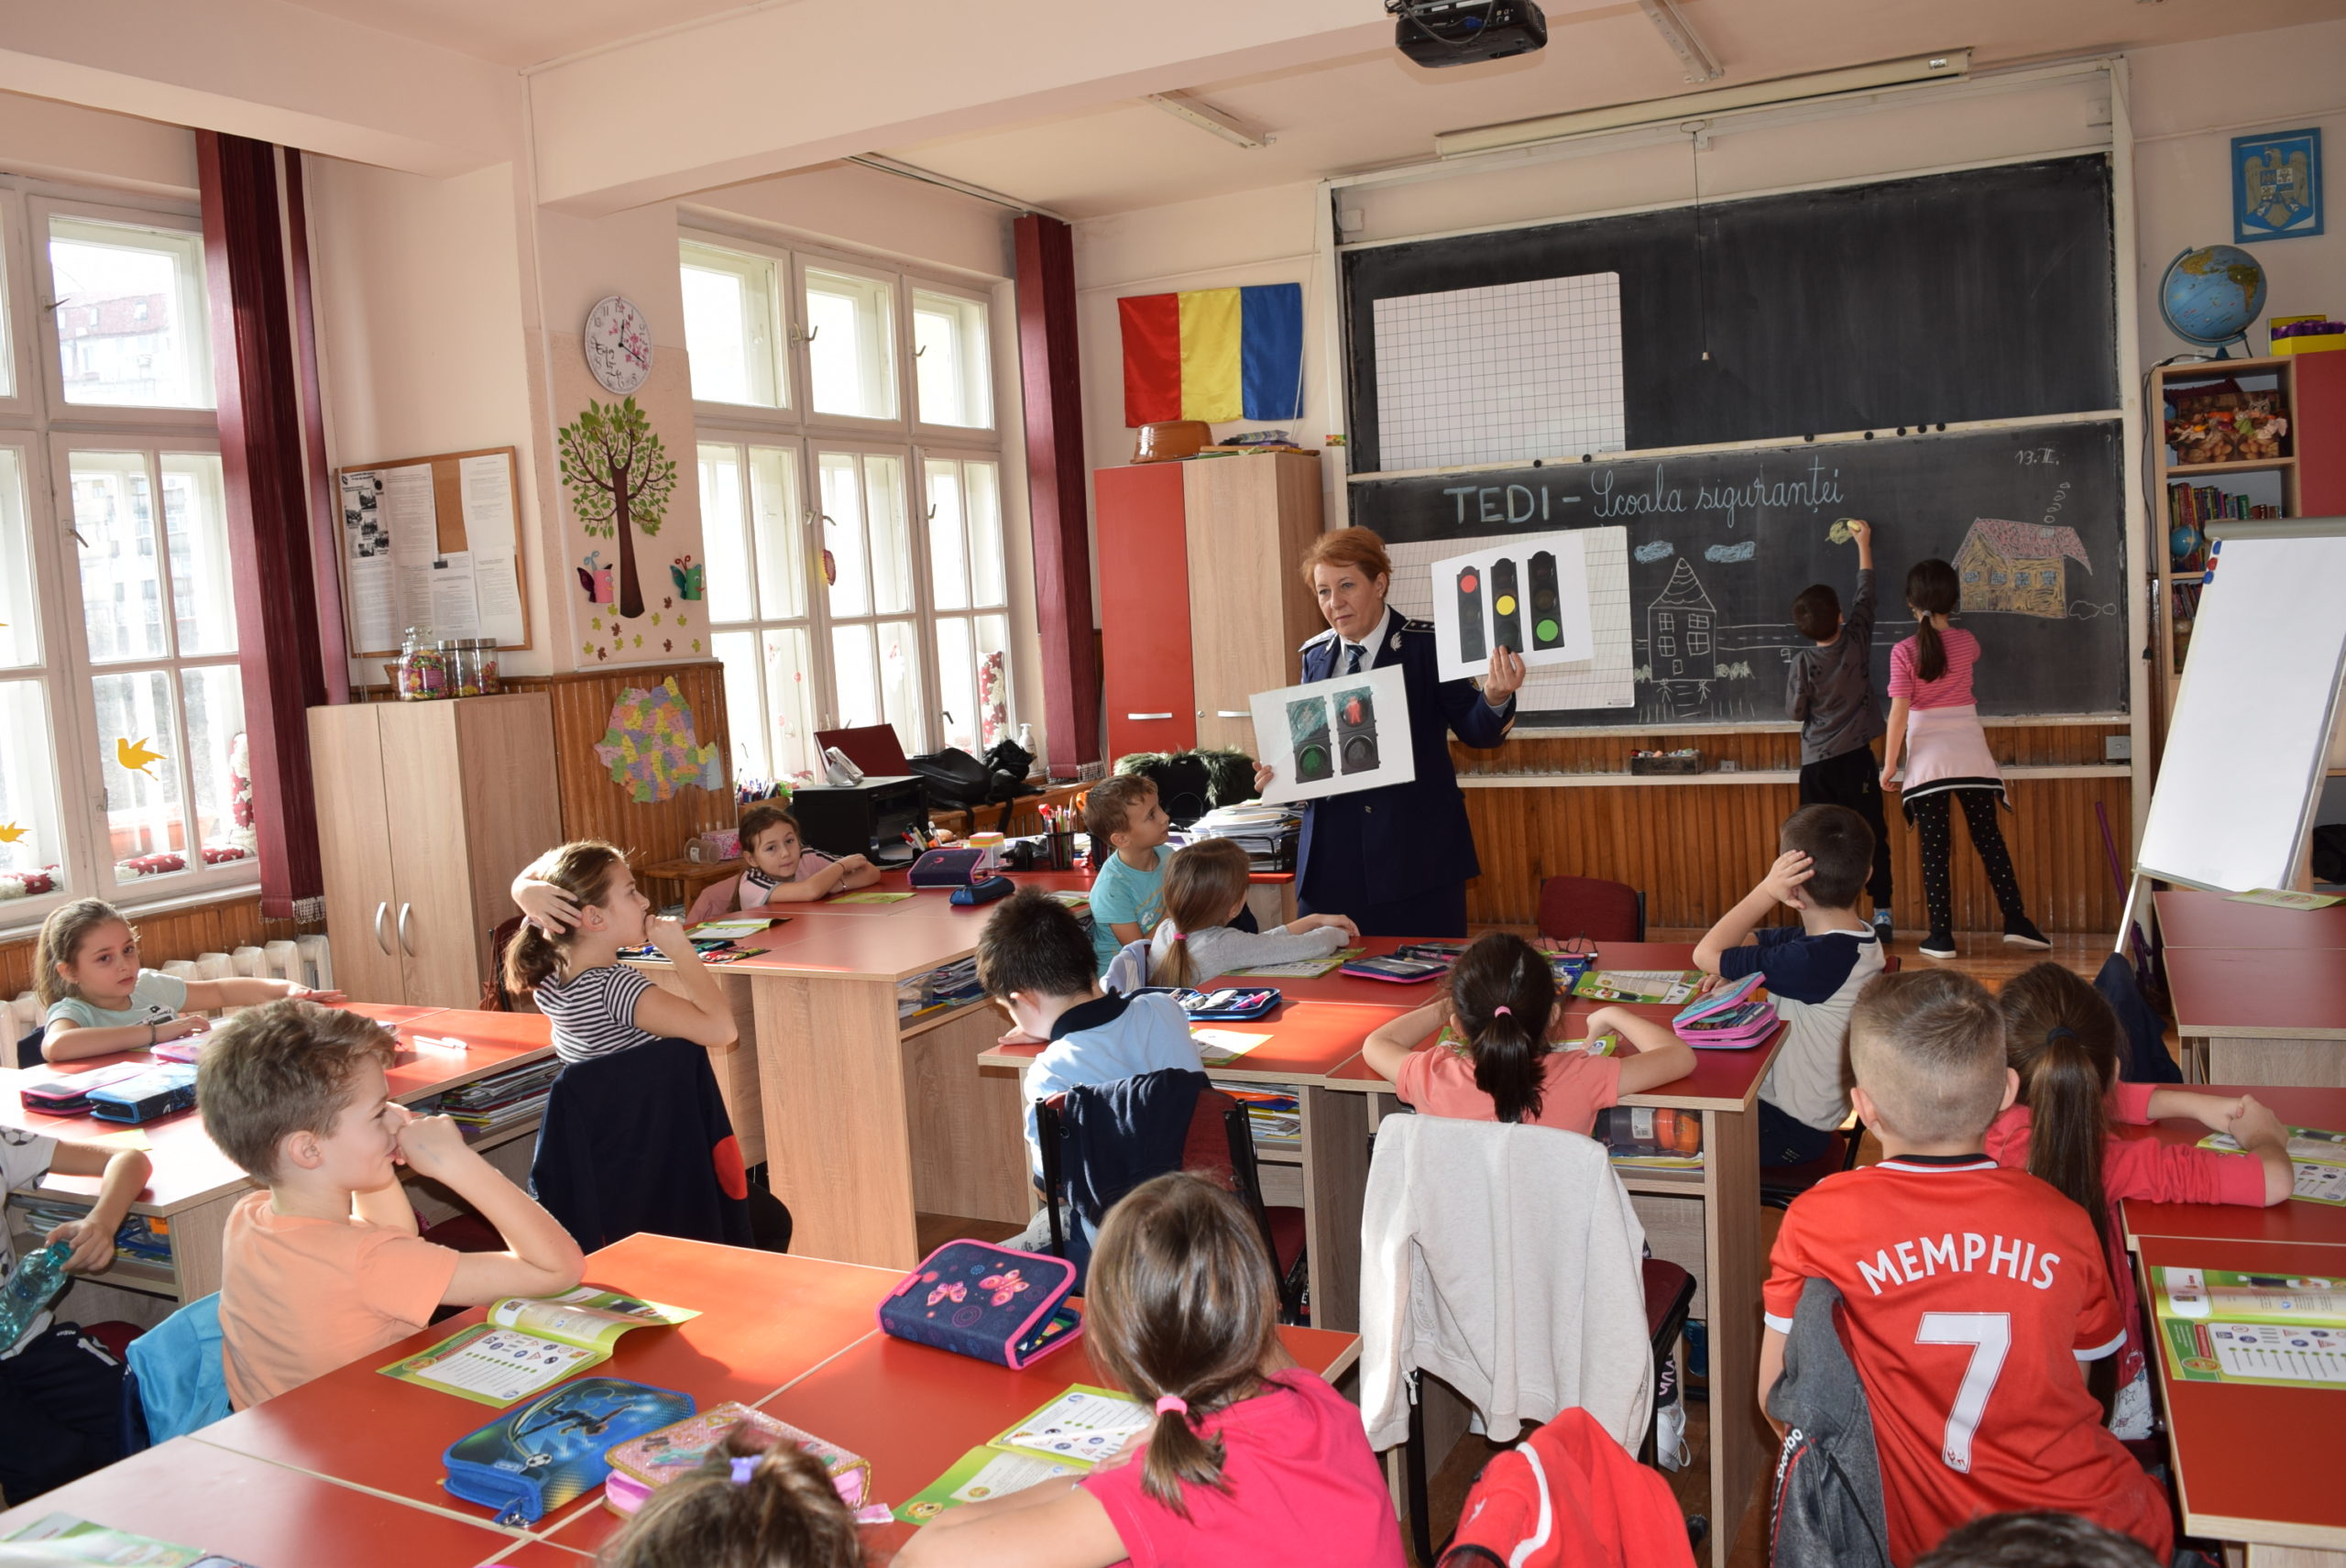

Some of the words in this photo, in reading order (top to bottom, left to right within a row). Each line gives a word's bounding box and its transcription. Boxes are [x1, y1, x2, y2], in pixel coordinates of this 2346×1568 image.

[1442, 484, 1550, 525] TEDI
[1856, 1233, 2061, 1296] MEMPHIS
[1914, 1311, 2012, 1474] 7
